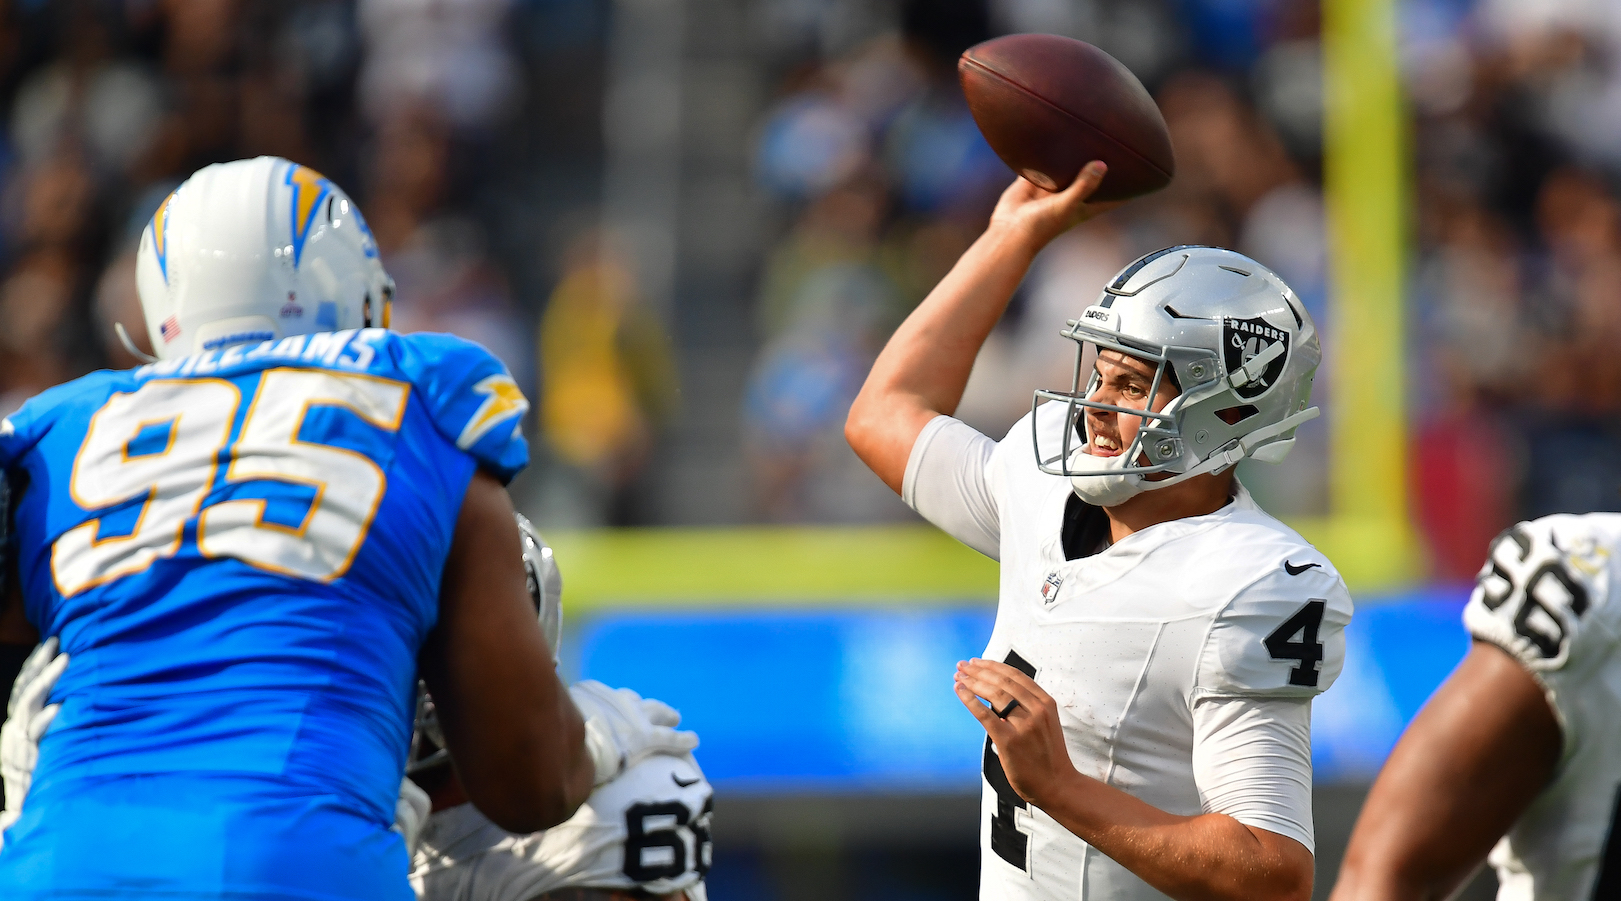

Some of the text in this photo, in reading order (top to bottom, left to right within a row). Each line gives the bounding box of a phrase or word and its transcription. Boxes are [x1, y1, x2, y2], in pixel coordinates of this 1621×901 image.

[1085, 310, 1110, 322] AIDERS
[1231, 319, 1285, 342] RAIDERS
[50, 367, 411, 599] 95
[1482, 526, 1588, 659] 66
[1263, 599, 1327, 687] 4
